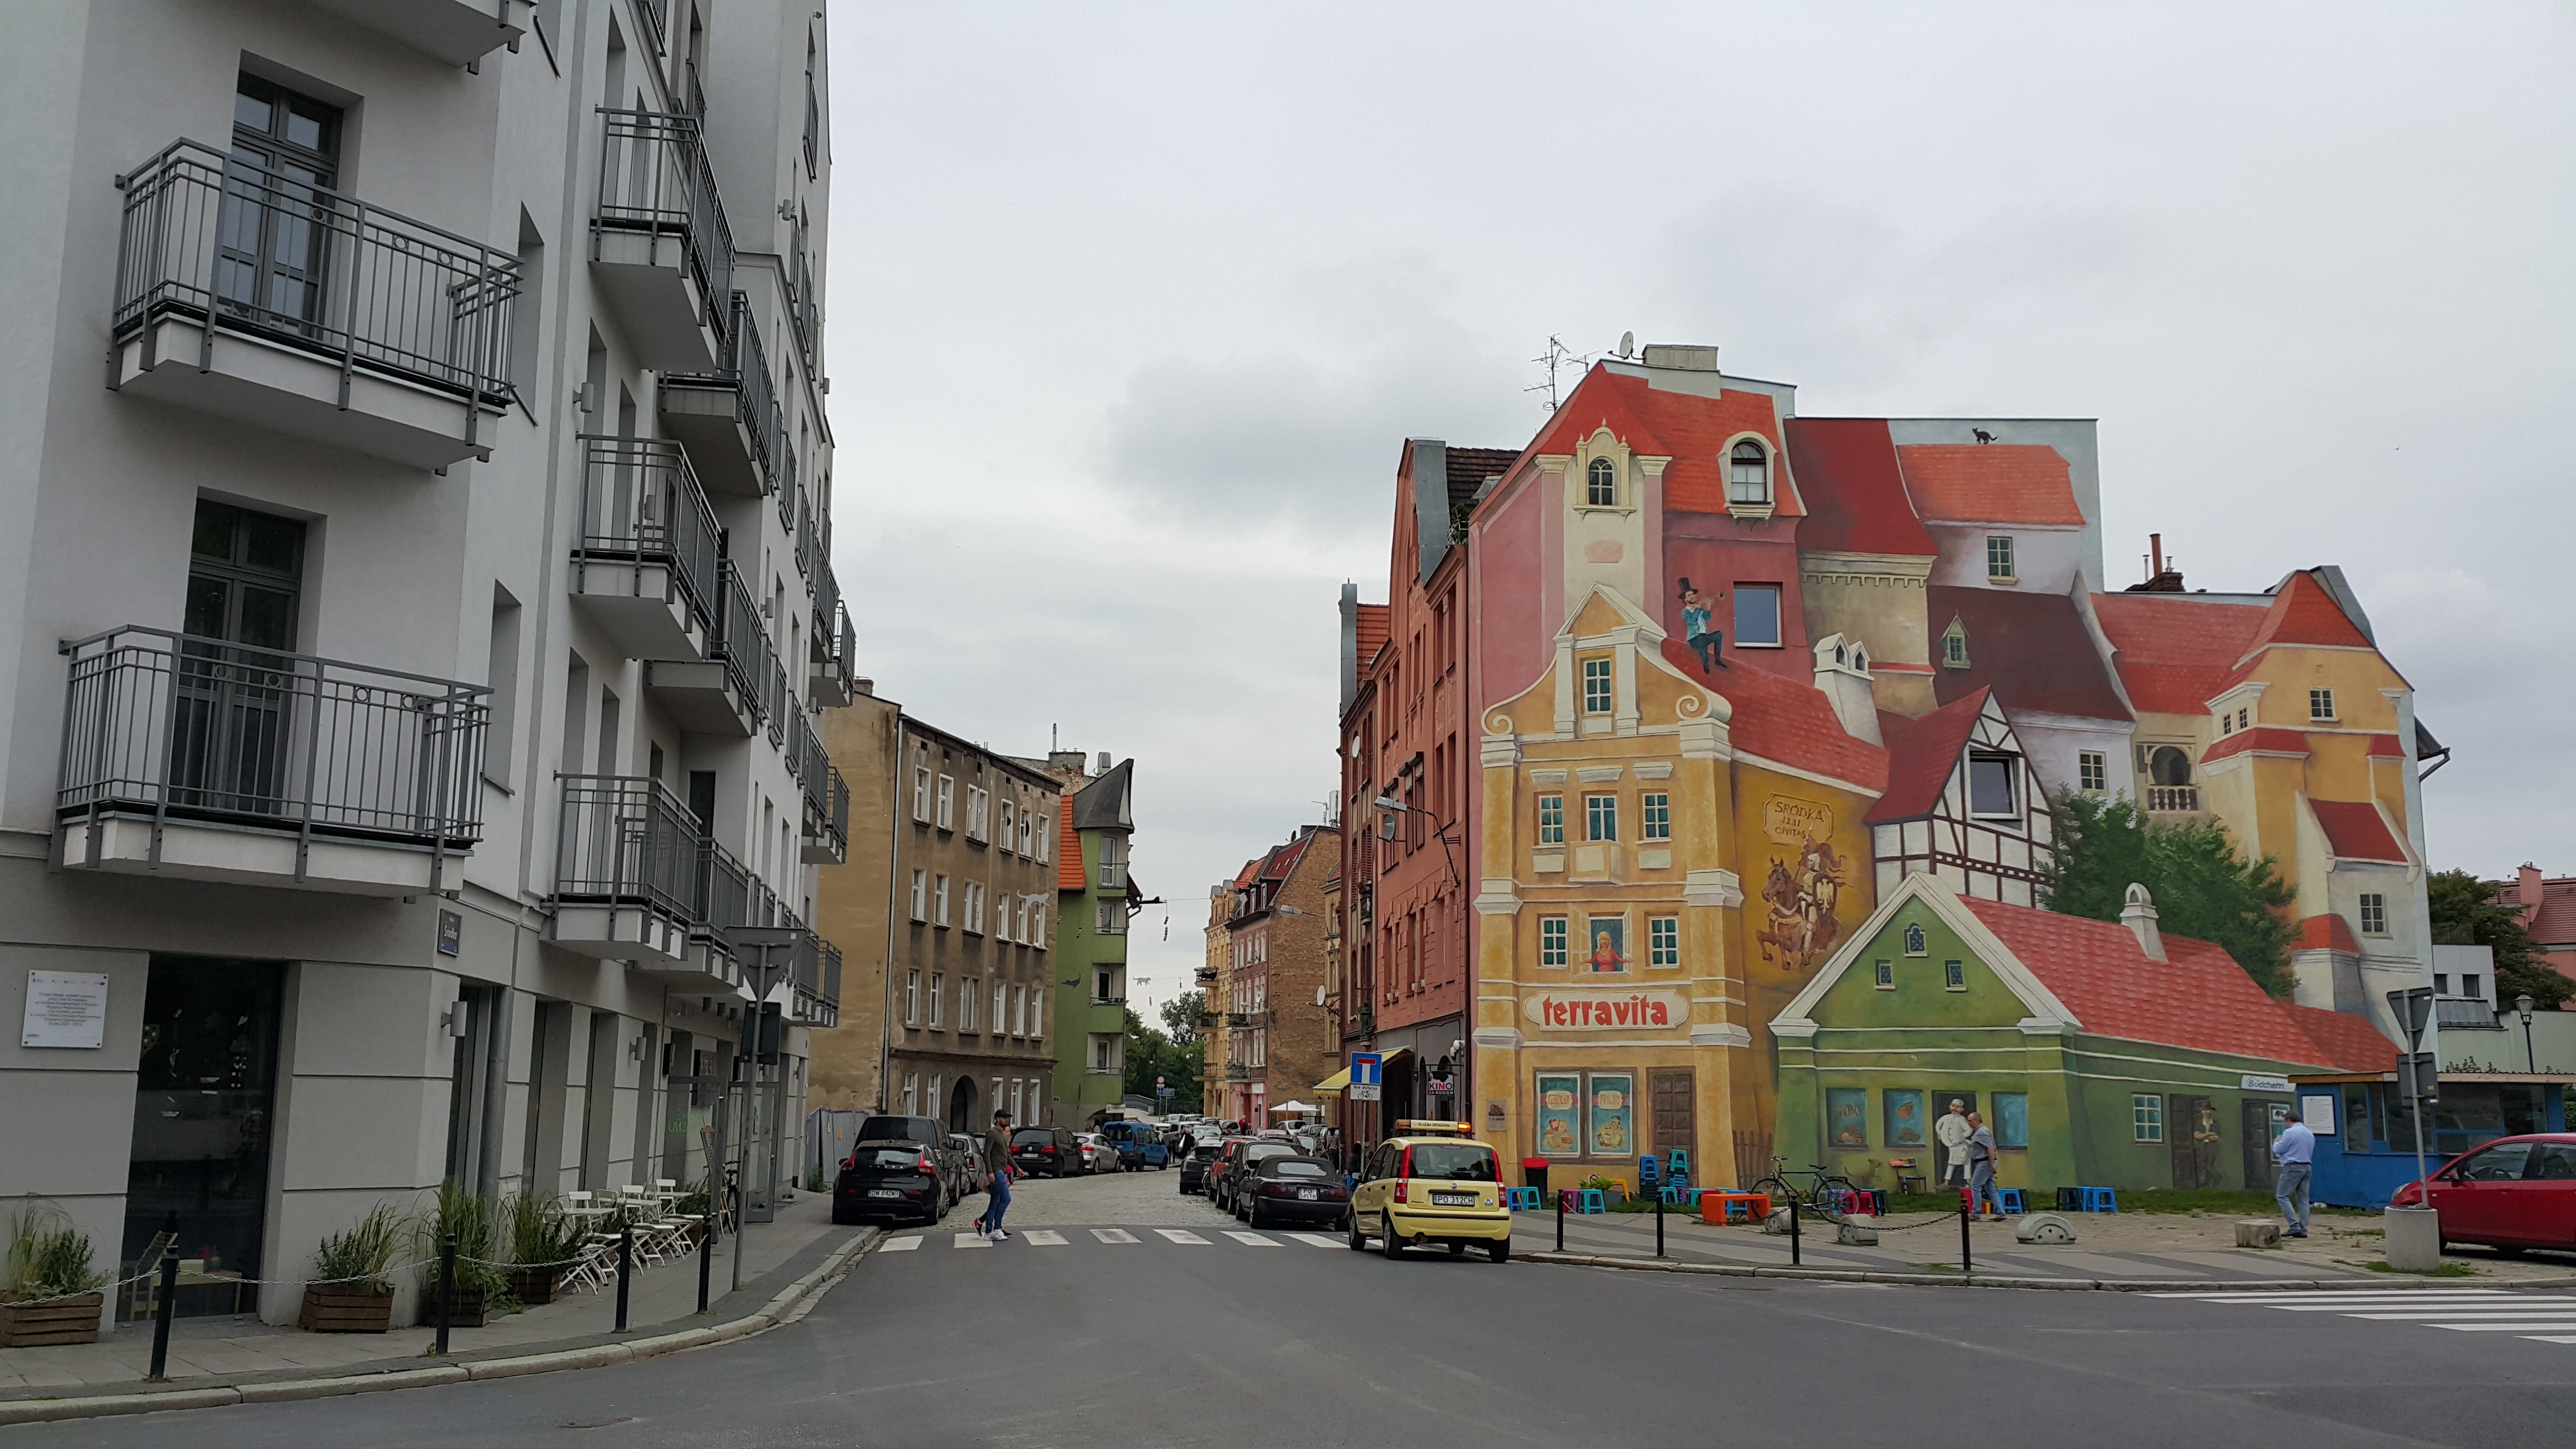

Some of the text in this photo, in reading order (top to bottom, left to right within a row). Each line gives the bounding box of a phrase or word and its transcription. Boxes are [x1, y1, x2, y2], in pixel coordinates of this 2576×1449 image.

[1782, 816, 1801, 826] 1231
[1775, 826, 1806, 839] CIVITAS
[1543, 994, 1668, 1026] terravita
[1451, 1196, 1473, 1205] 312CH
